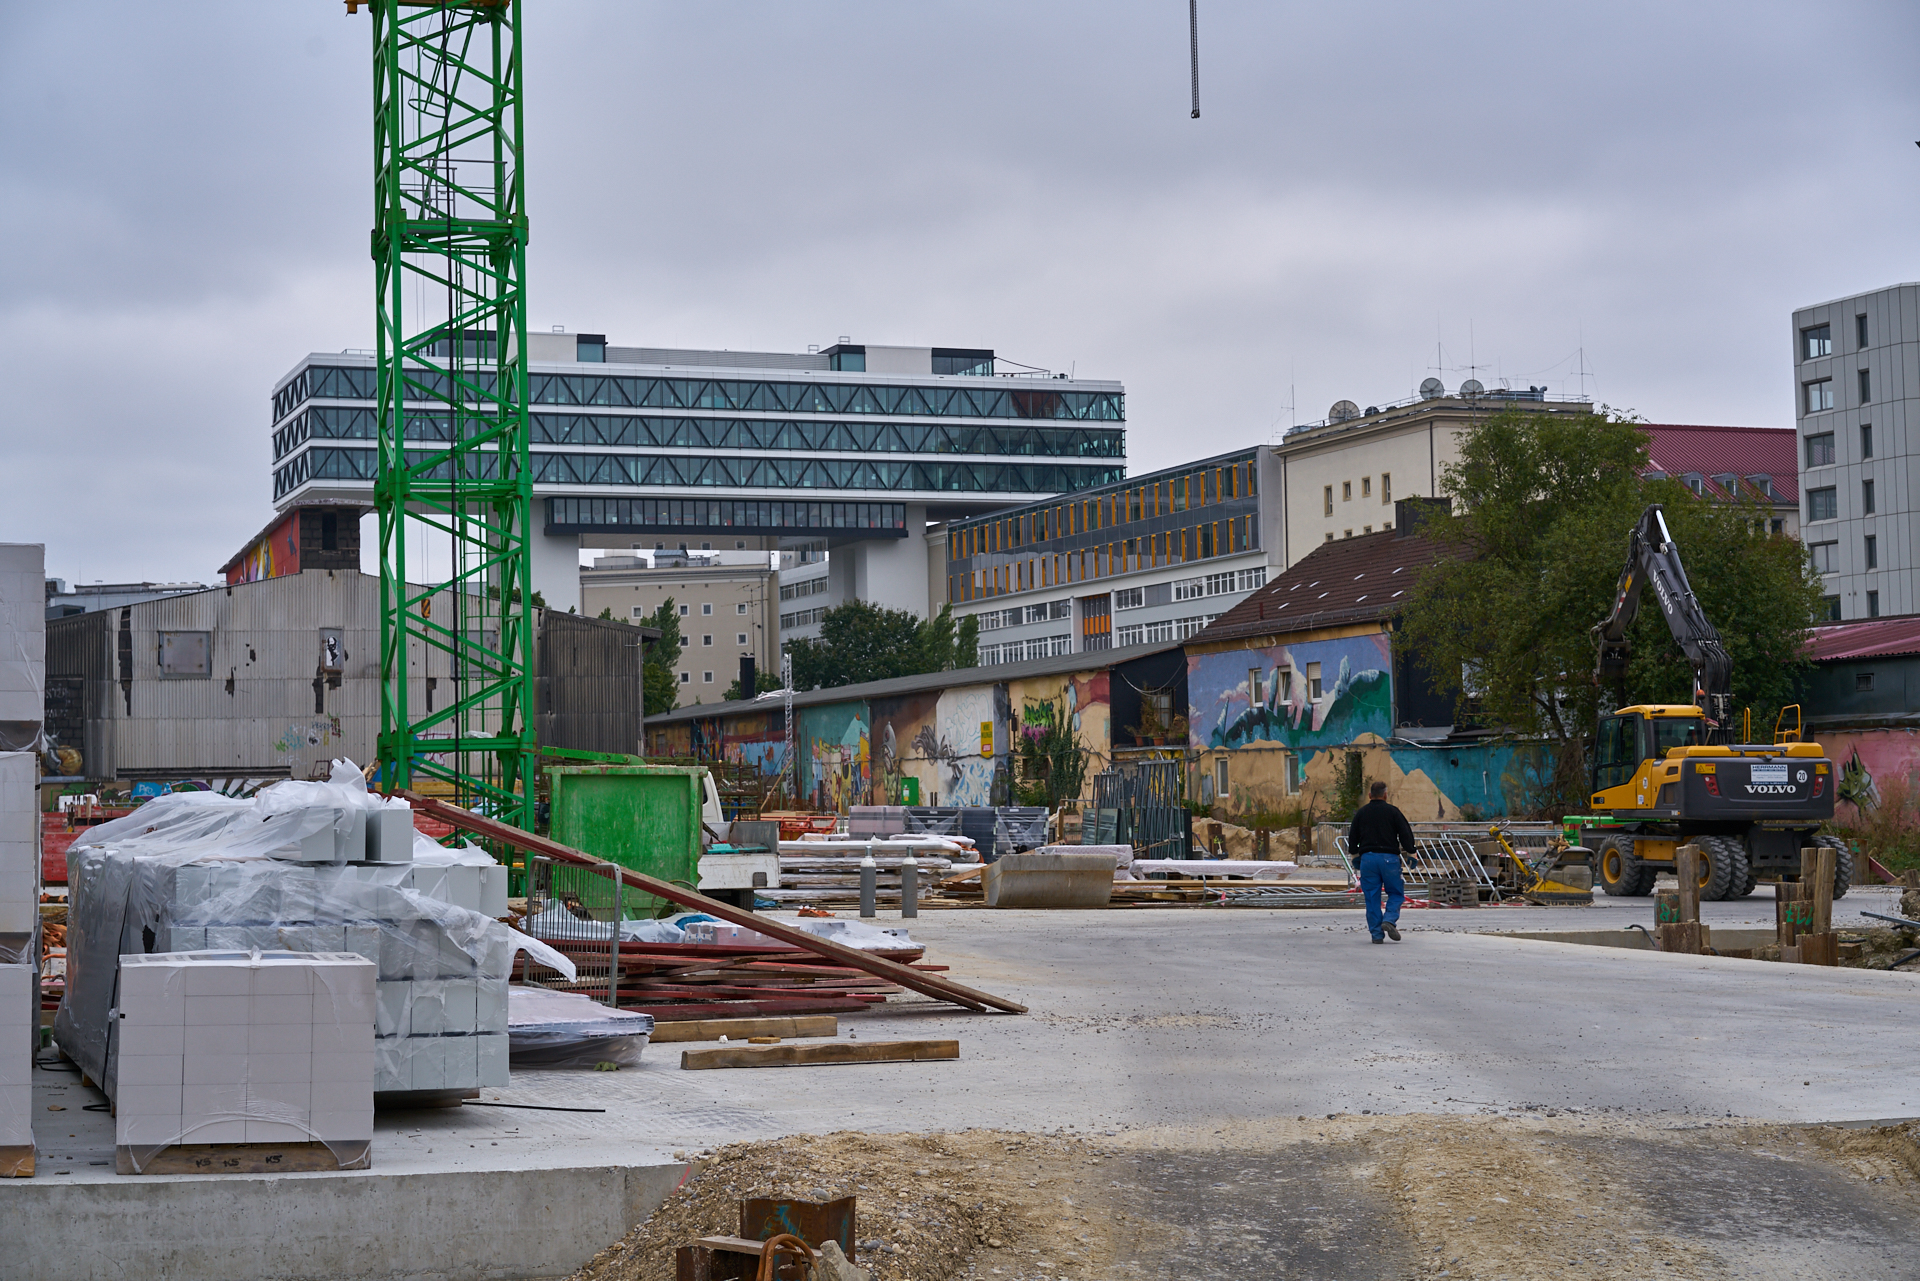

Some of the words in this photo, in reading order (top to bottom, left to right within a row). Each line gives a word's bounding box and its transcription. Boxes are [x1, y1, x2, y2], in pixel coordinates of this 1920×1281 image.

[1653, 569, 1673, 615] VOLVO
[1798, 772, 1805, 780] 20
[1744, 785, 1796, 794] VOLVO
